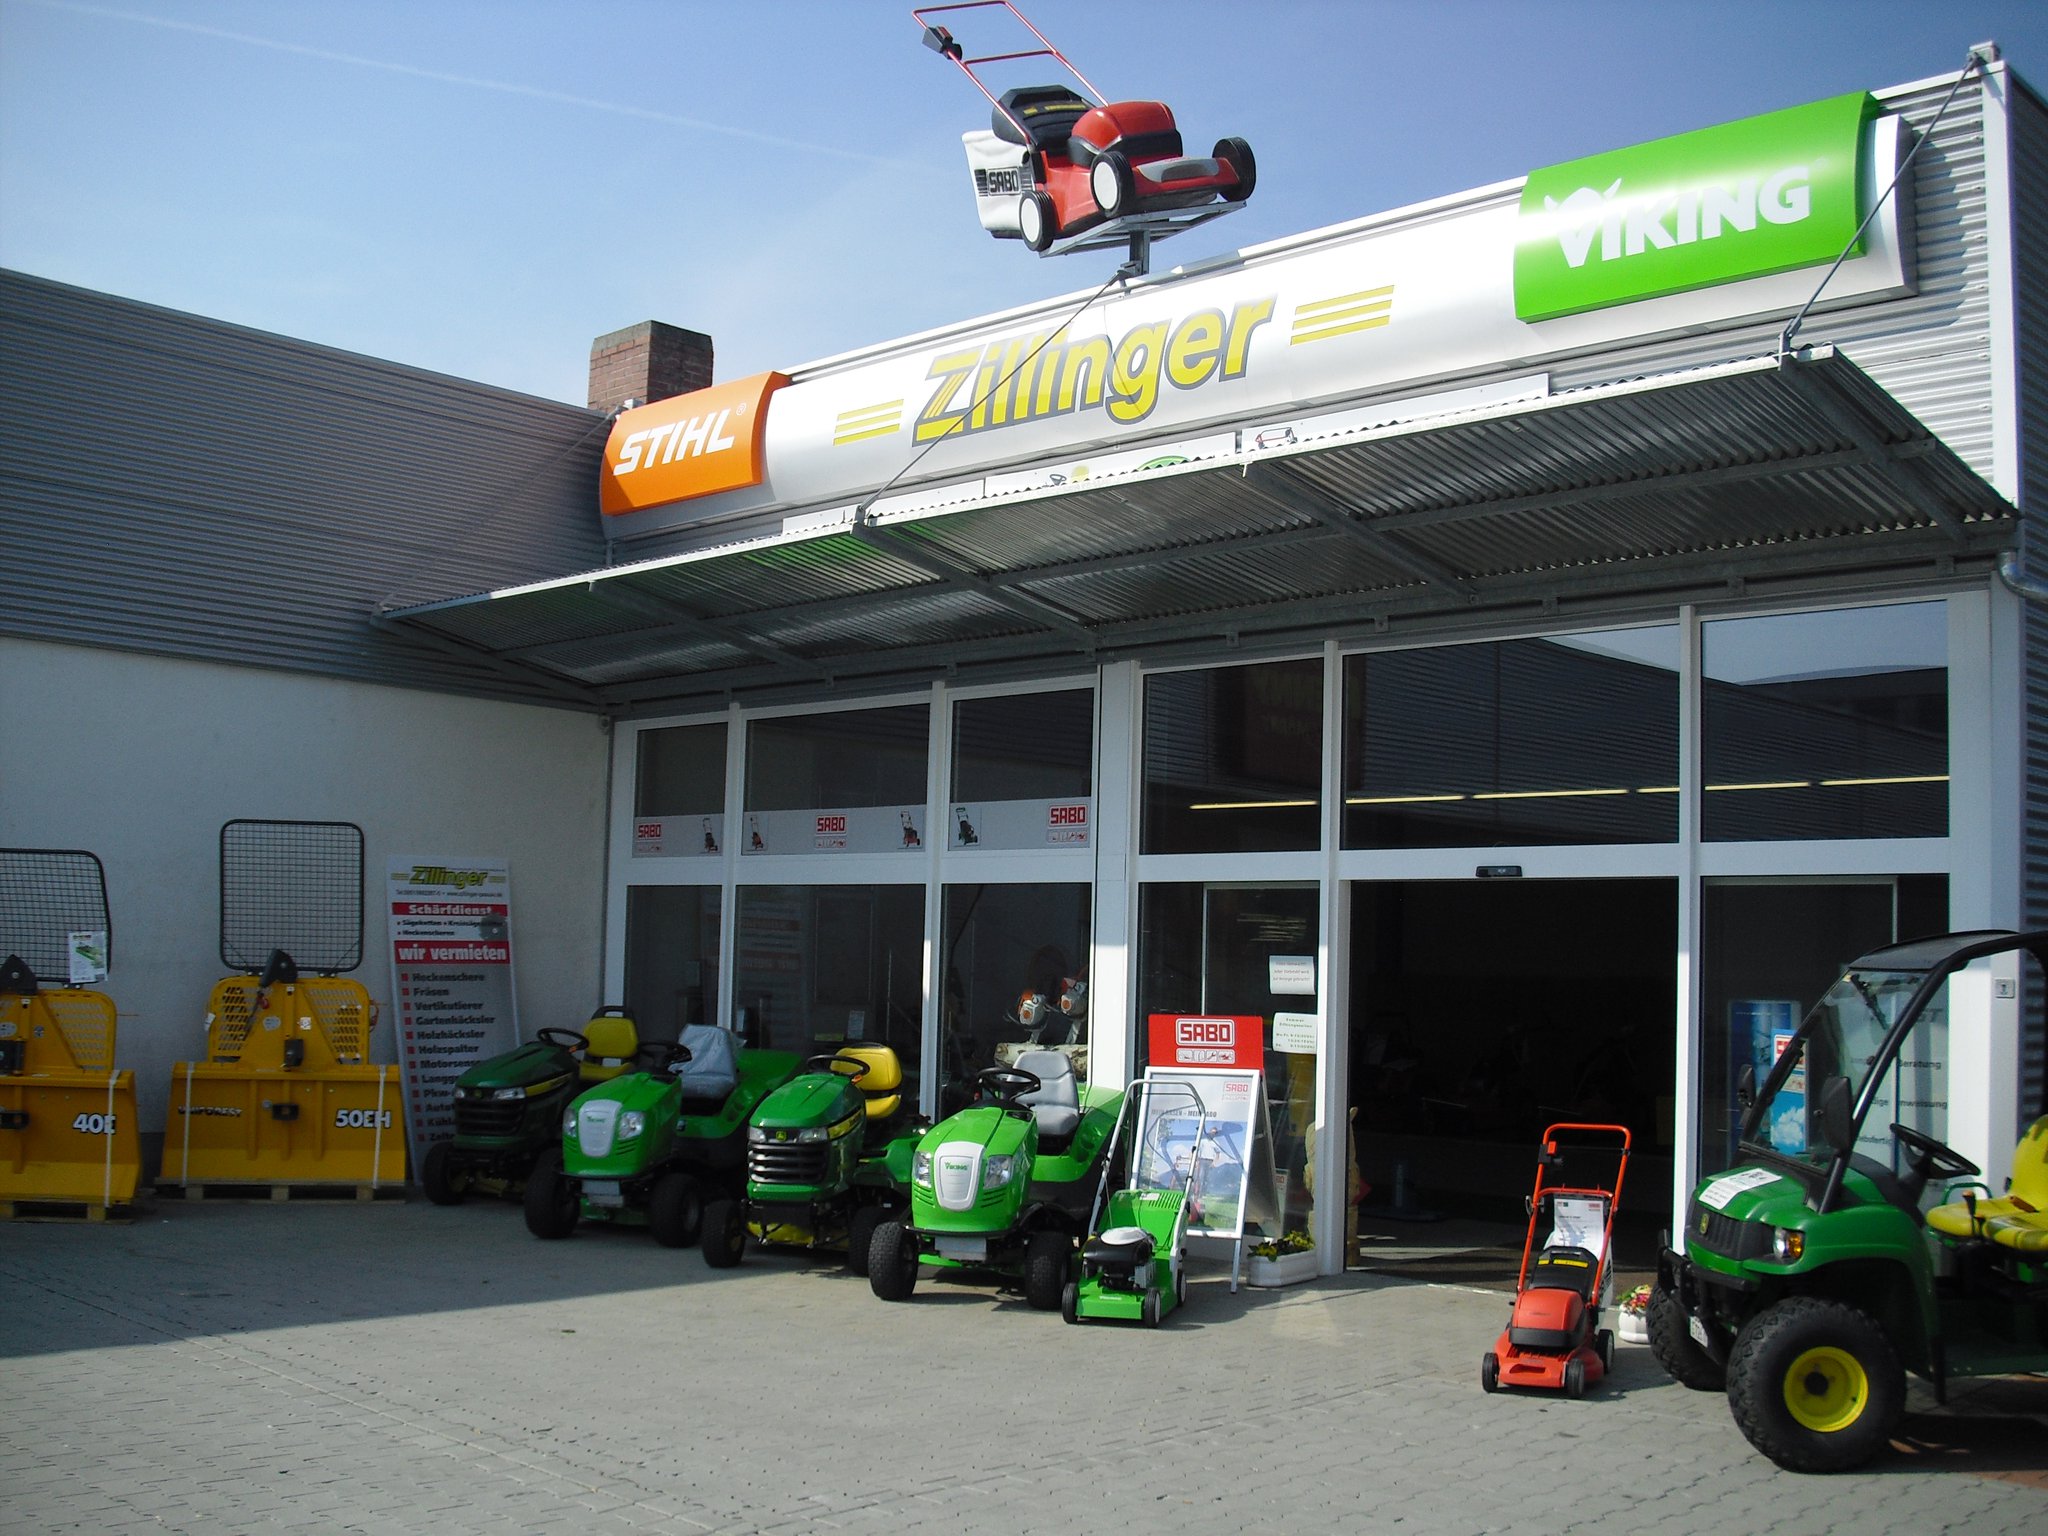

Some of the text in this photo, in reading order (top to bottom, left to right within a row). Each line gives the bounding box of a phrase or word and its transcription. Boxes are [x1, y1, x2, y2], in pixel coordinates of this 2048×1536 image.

[988, 170, 1019, 193] SABO
[1544, 165, 1811, 268] VIKING
[912, 293, 1278, 448] Zillinger
[613, 407, 735, 476] STIHL
[817, 816, 846, 832] SABO
[1050, 806, 1086, 825] SABO
[637, 823, 662, 839] SABO
[409, 865, 488, 889] Zillinger
[409, 904, 492, 916] Schärfdienst
[398, 944, 507, 961] wir vermieten
[1179, 1023, 1232, 1043] SABO
[1225, 1083, 1249, 1092] SABO
[335, 1109, 391, 1129] 50EH
